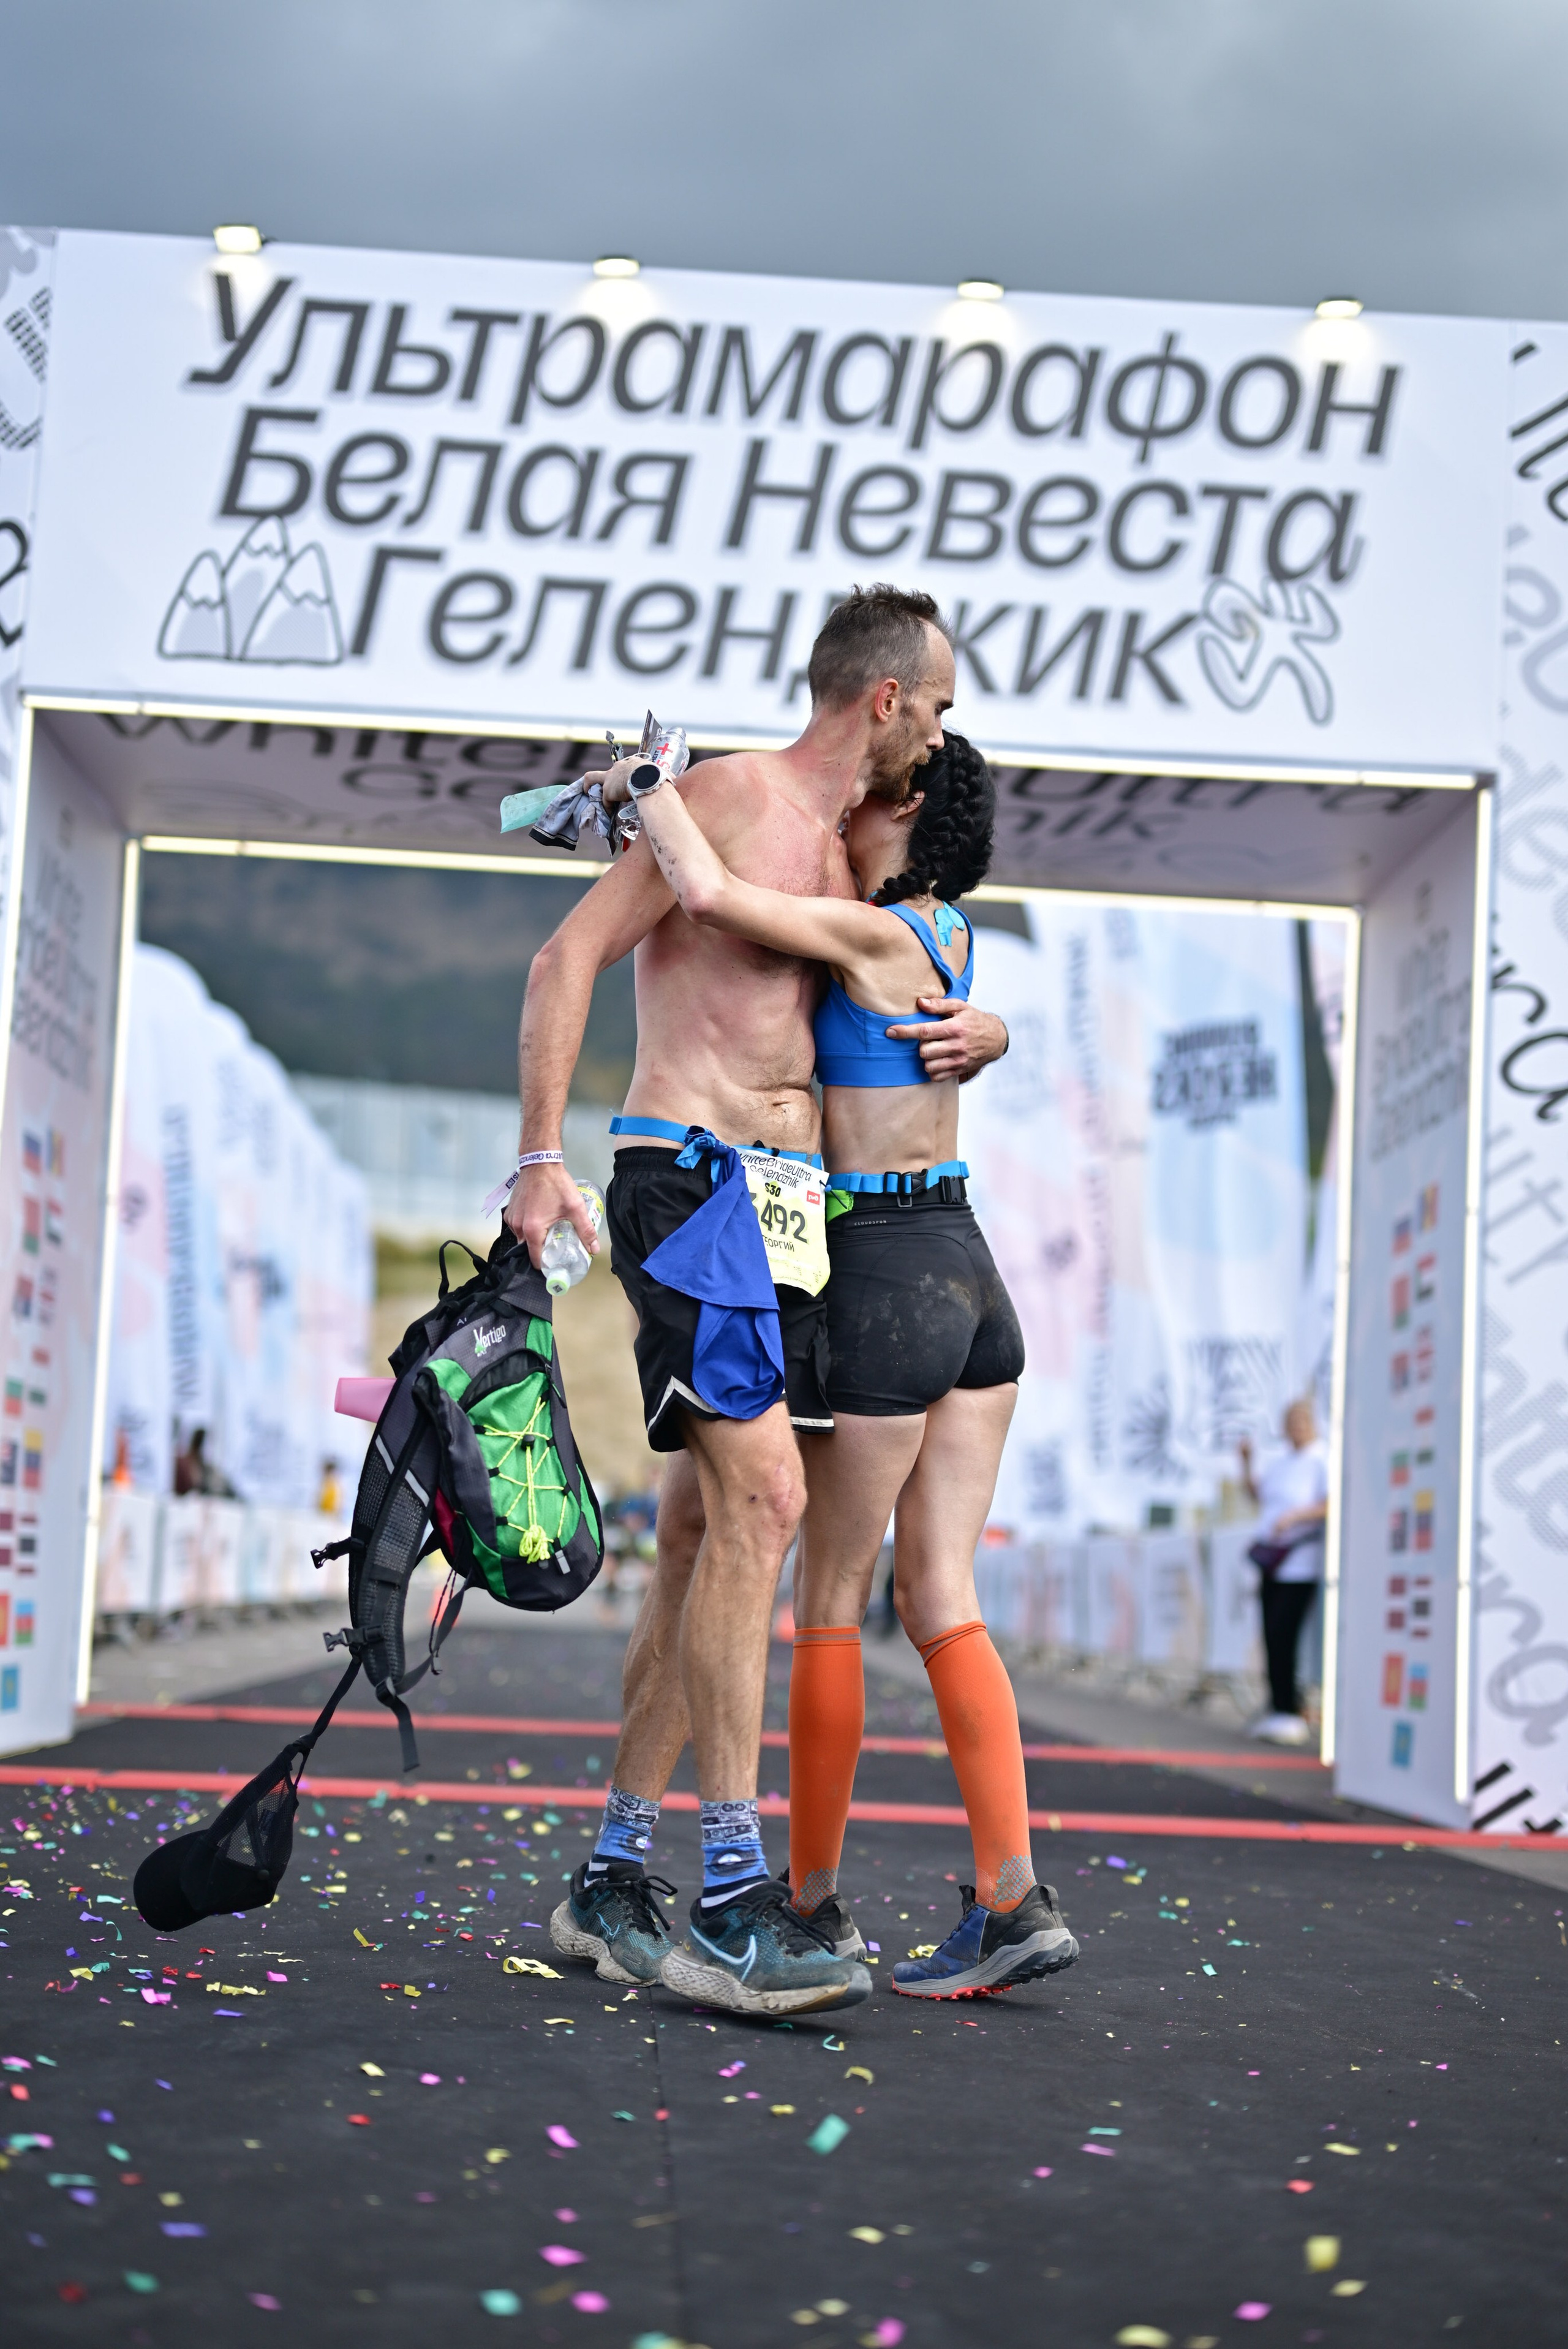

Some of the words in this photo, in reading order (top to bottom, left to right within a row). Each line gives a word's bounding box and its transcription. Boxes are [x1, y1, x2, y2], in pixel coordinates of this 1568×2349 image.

[187, 270, 1401, 463] Ультрамарафон
[218, 405, 691, 545] Белая
[726, 440, 1365, 584] Невеста
[764, 1182, 782, 1198] S30
[762, 1234, 794, 1252] ЕОРГИЙ
[473, 1325, 506, 1349] Vertigo
